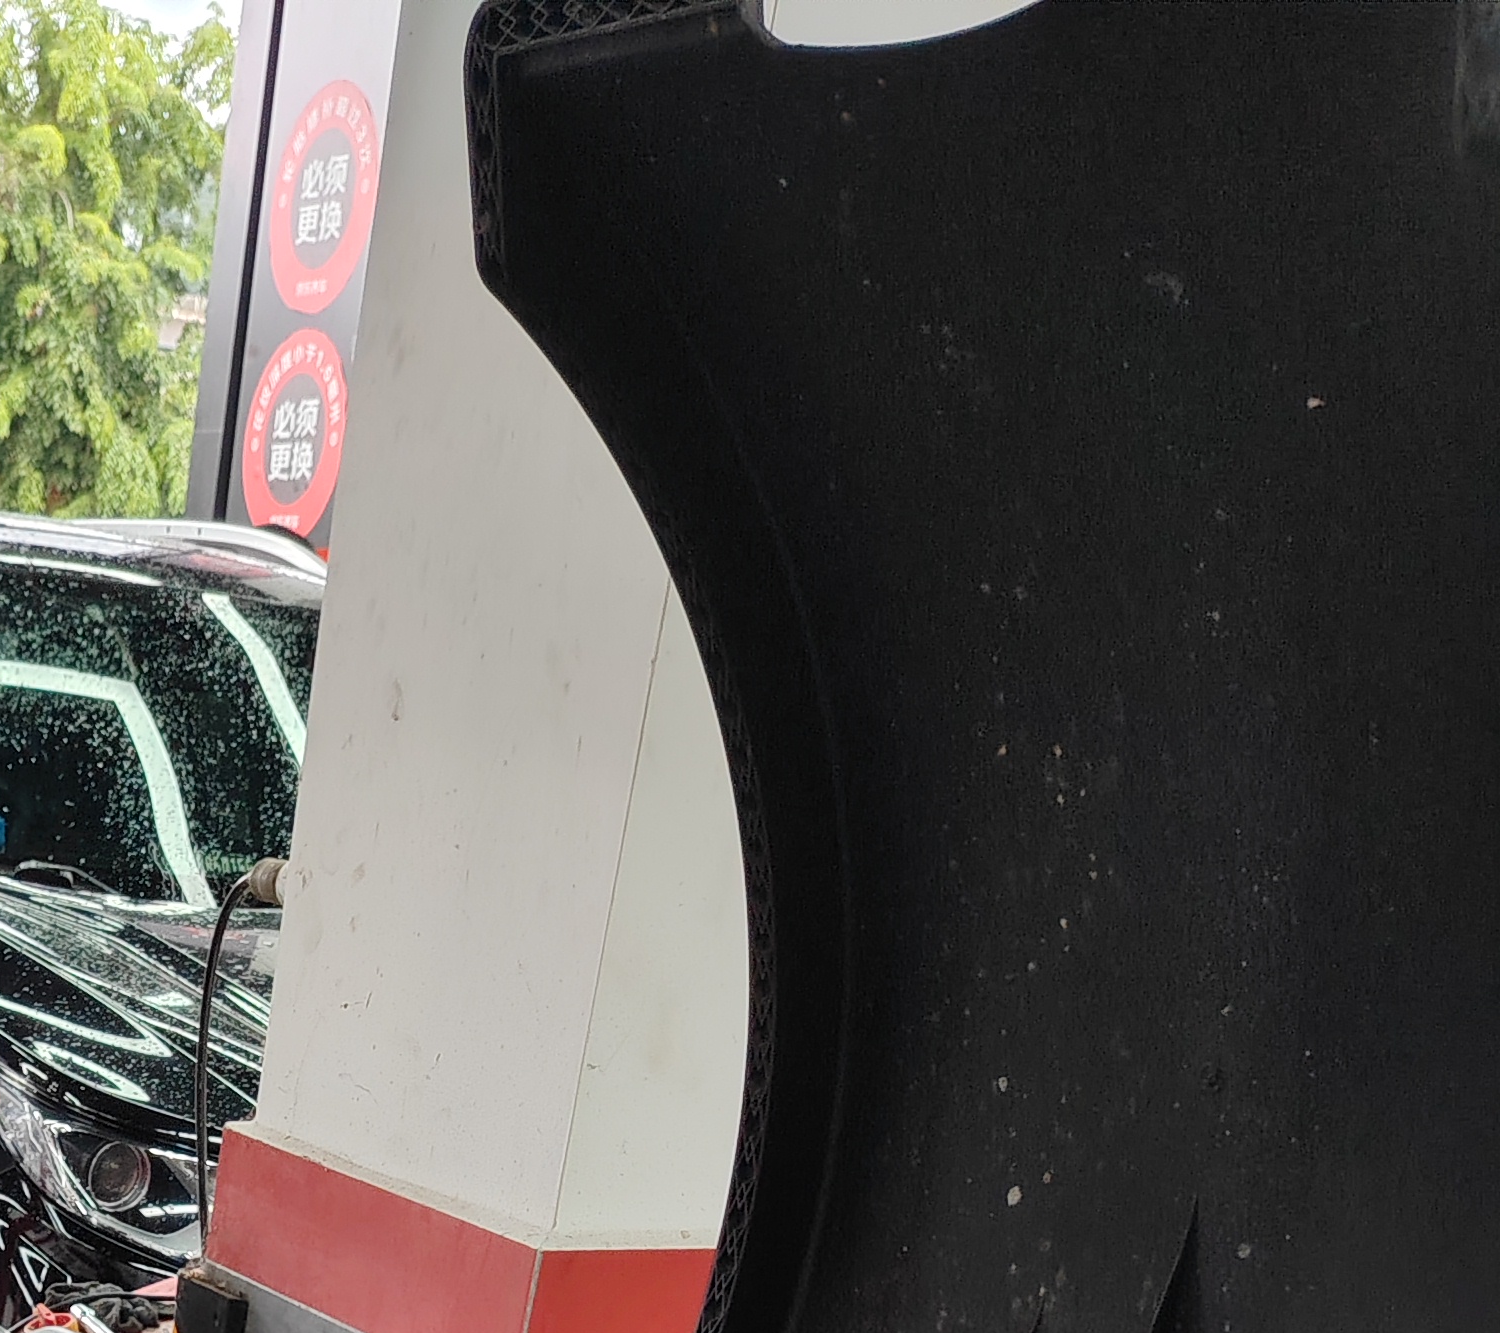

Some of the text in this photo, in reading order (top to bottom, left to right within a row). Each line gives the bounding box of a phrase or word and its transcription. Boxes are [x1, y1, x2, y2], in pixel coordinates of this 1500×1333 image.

[301, 154, 350, 199] 必须
[295, 201, 342, 246] 更换
[272, 397, 320, 439] 必须
[268, 441, 313, 482] 更换
